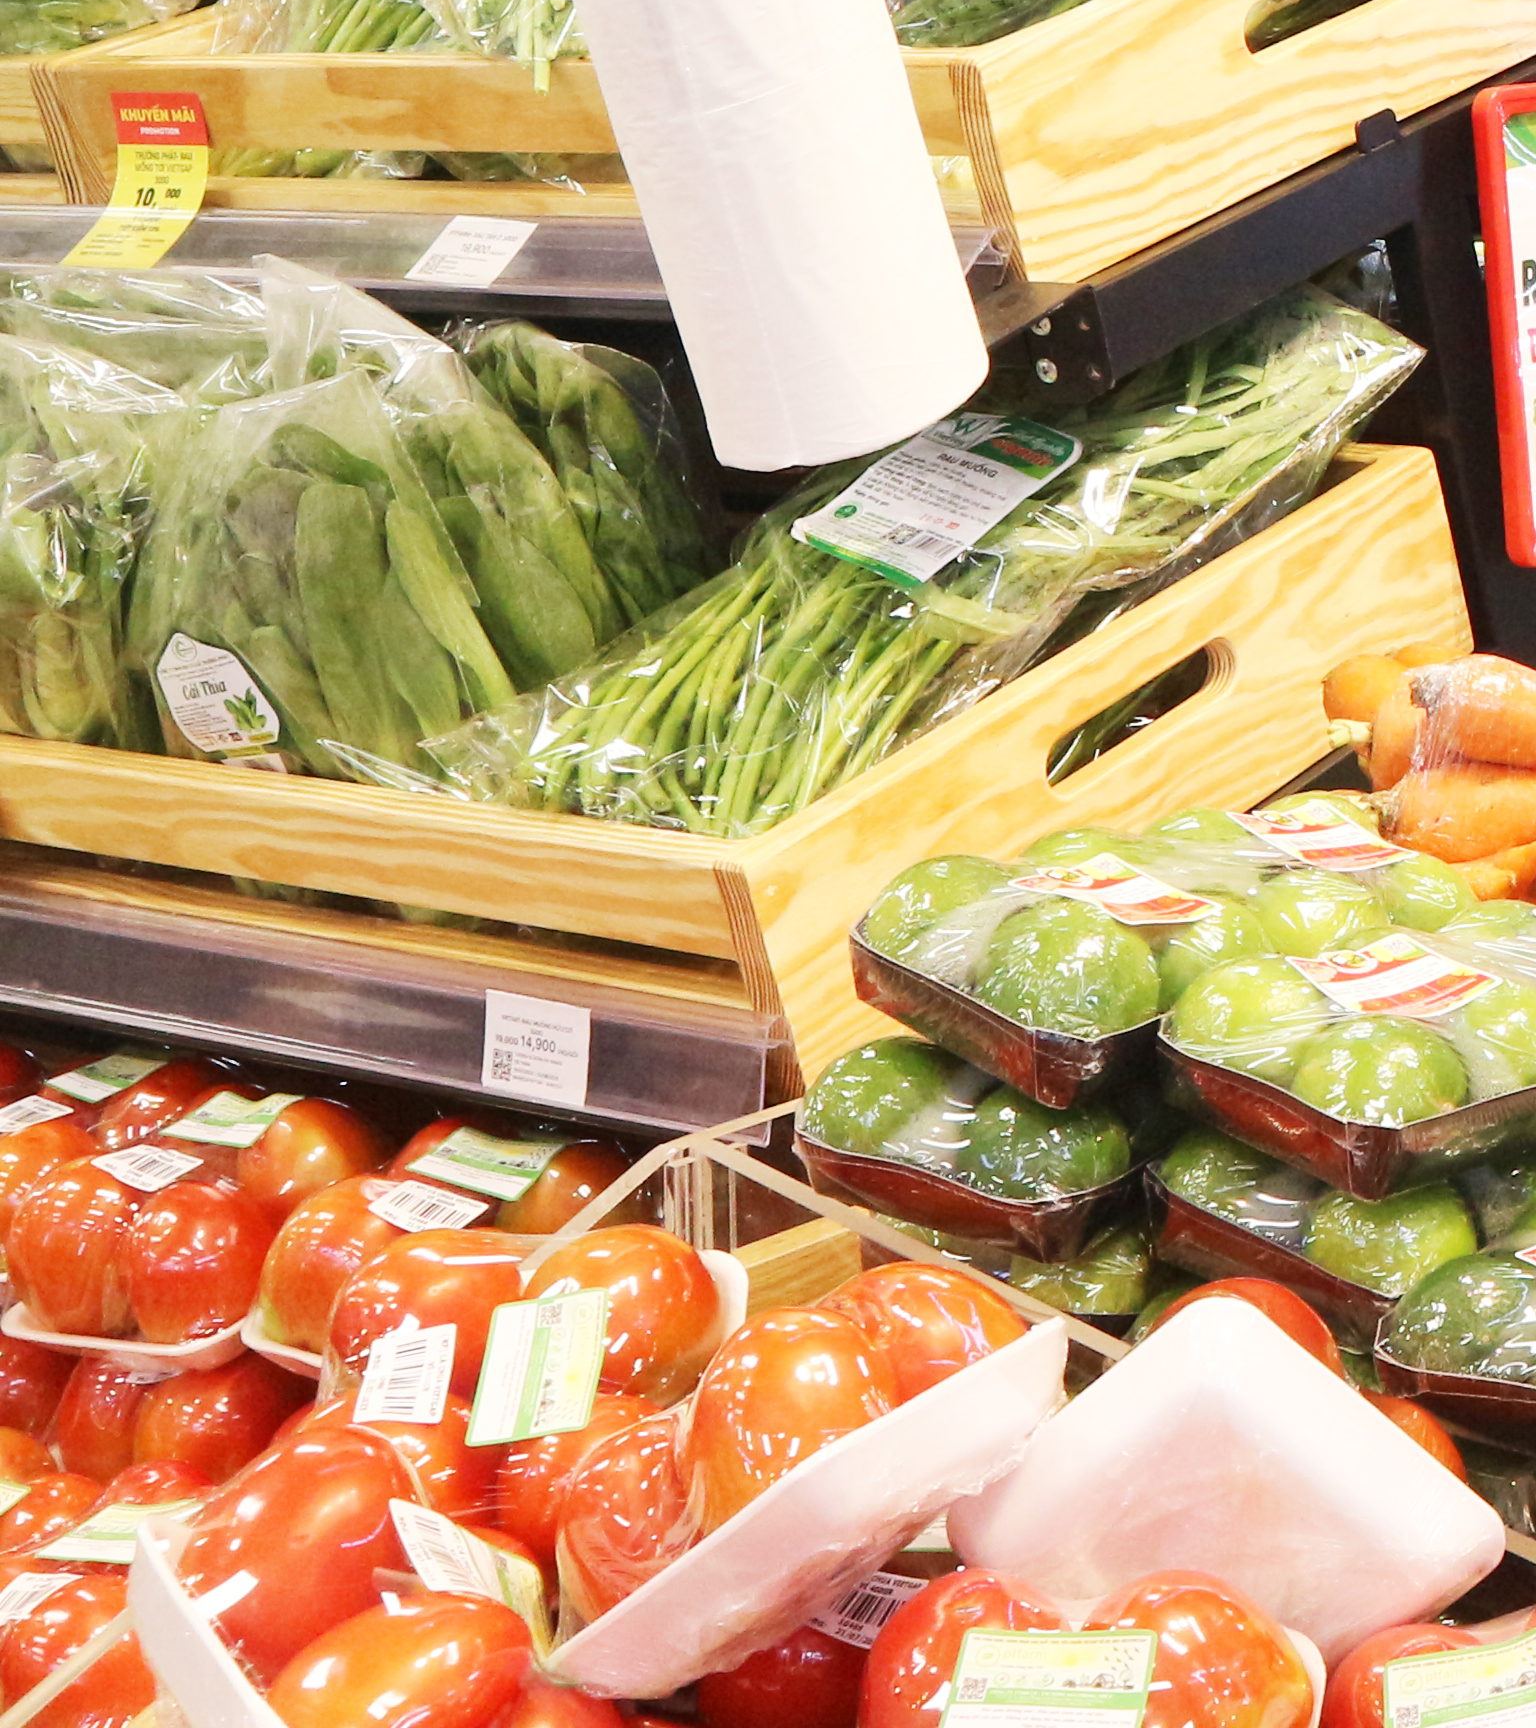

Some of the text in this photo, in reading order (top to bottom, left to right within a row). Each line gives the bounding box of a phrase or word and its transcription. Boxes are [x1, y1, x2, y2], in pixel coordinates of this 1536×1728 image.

[120, 104, 196, 123] KHUYẾN MÃI
[936, 452, 999, 479] RAU MUỐNG
[521, 1035, 556, 1053] 14,900
